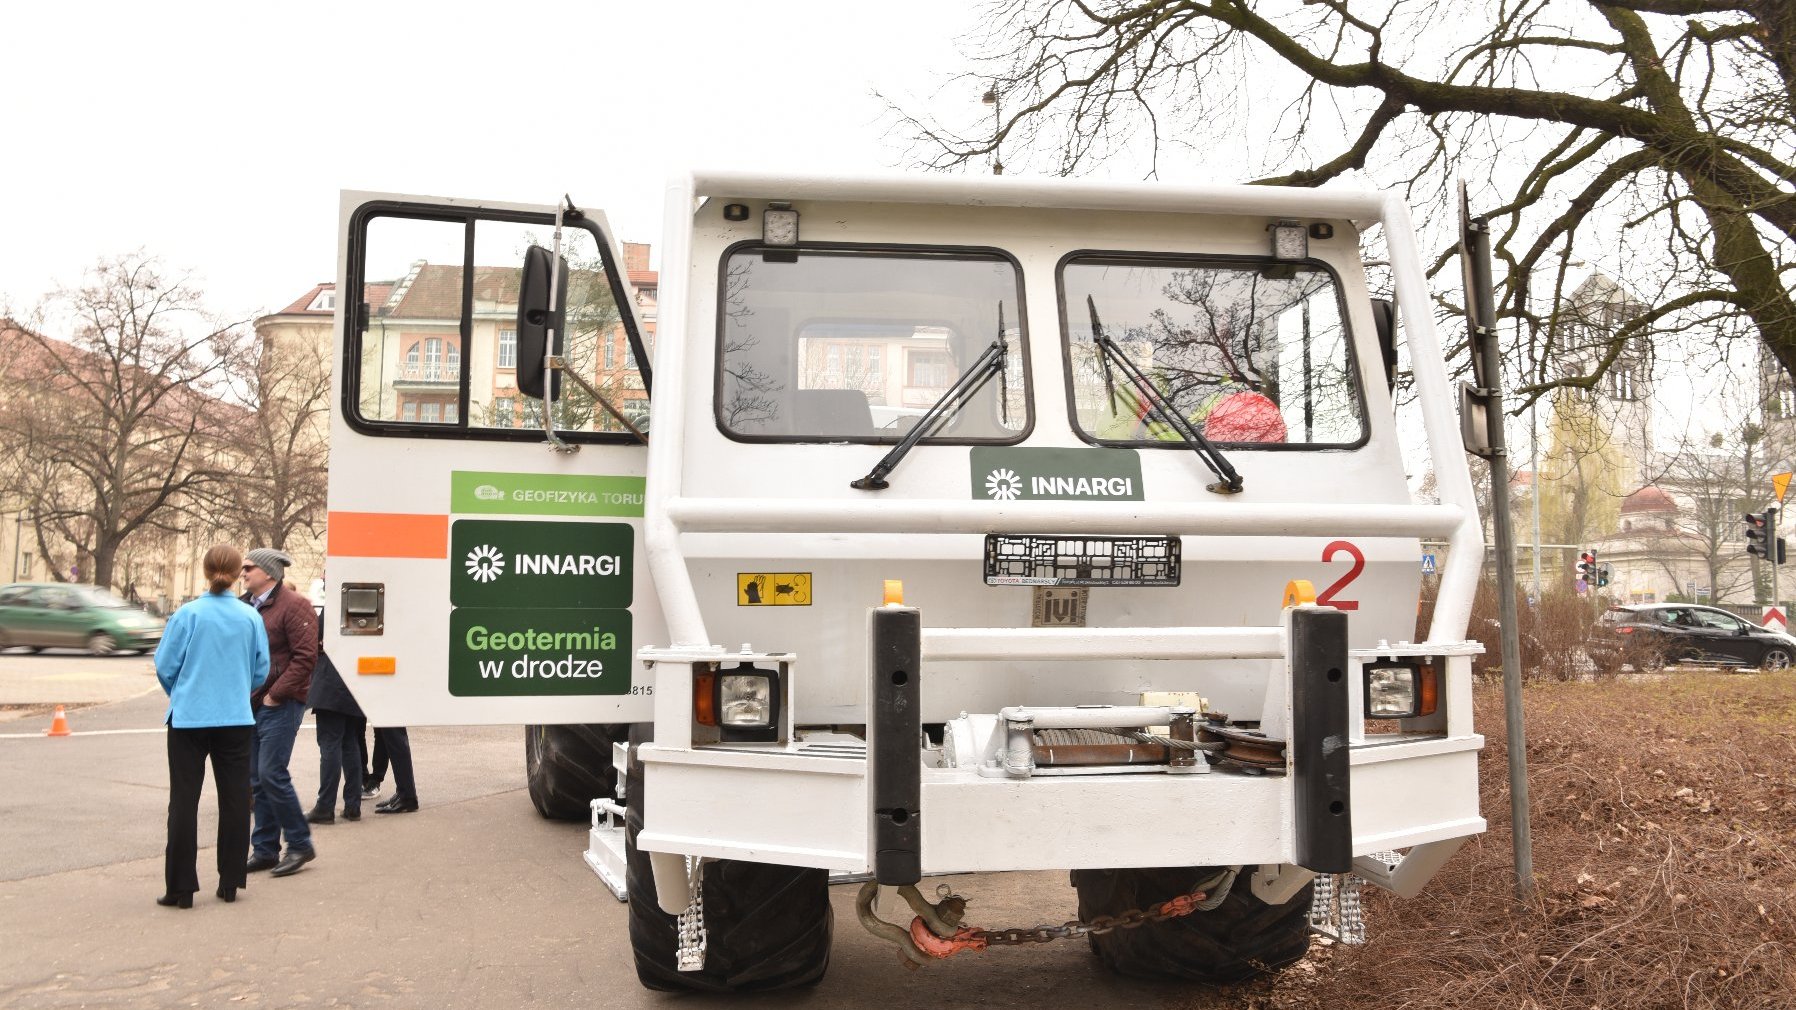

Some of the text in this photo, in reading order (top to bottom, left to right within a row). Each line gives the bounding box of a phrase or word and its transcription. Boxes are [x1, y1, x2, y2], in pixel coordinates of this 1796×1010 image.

[512, 489, 644, 505] GEOFIZYKA TORU
[1031, 476, 1133, 496] INNARGI
[515, 553, 621, 576] INNARGI
[1315, 540, 1366, 611] 2
[466, 625, 616, 651] Geotermia
[478, 654, 603, 679] w drodze
